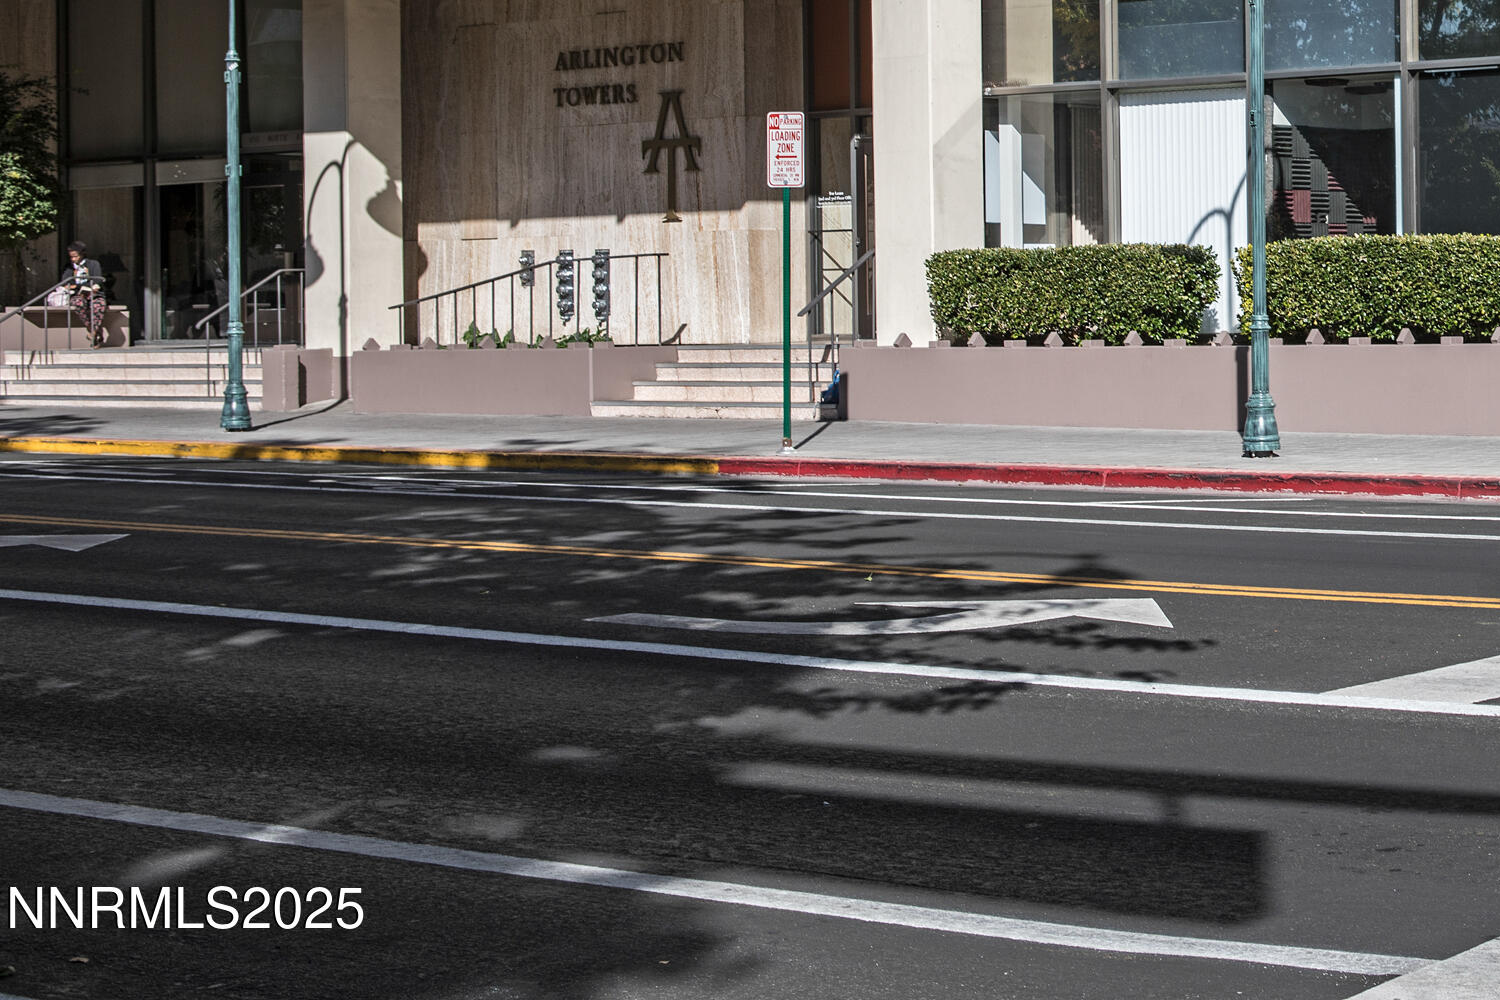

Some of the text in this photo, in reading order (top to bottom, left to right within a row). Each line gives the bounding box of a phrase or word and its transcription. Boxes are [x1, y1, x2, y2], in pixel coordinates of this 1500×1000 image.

[555, 41, 684, 71] ARLINGTON
[553, 84, 638, 108] TOWERS
[769, 116, 779, 127] NO
[771, 131, 800, 141] LOADING
[777, 142, 794, 153] ZONE
